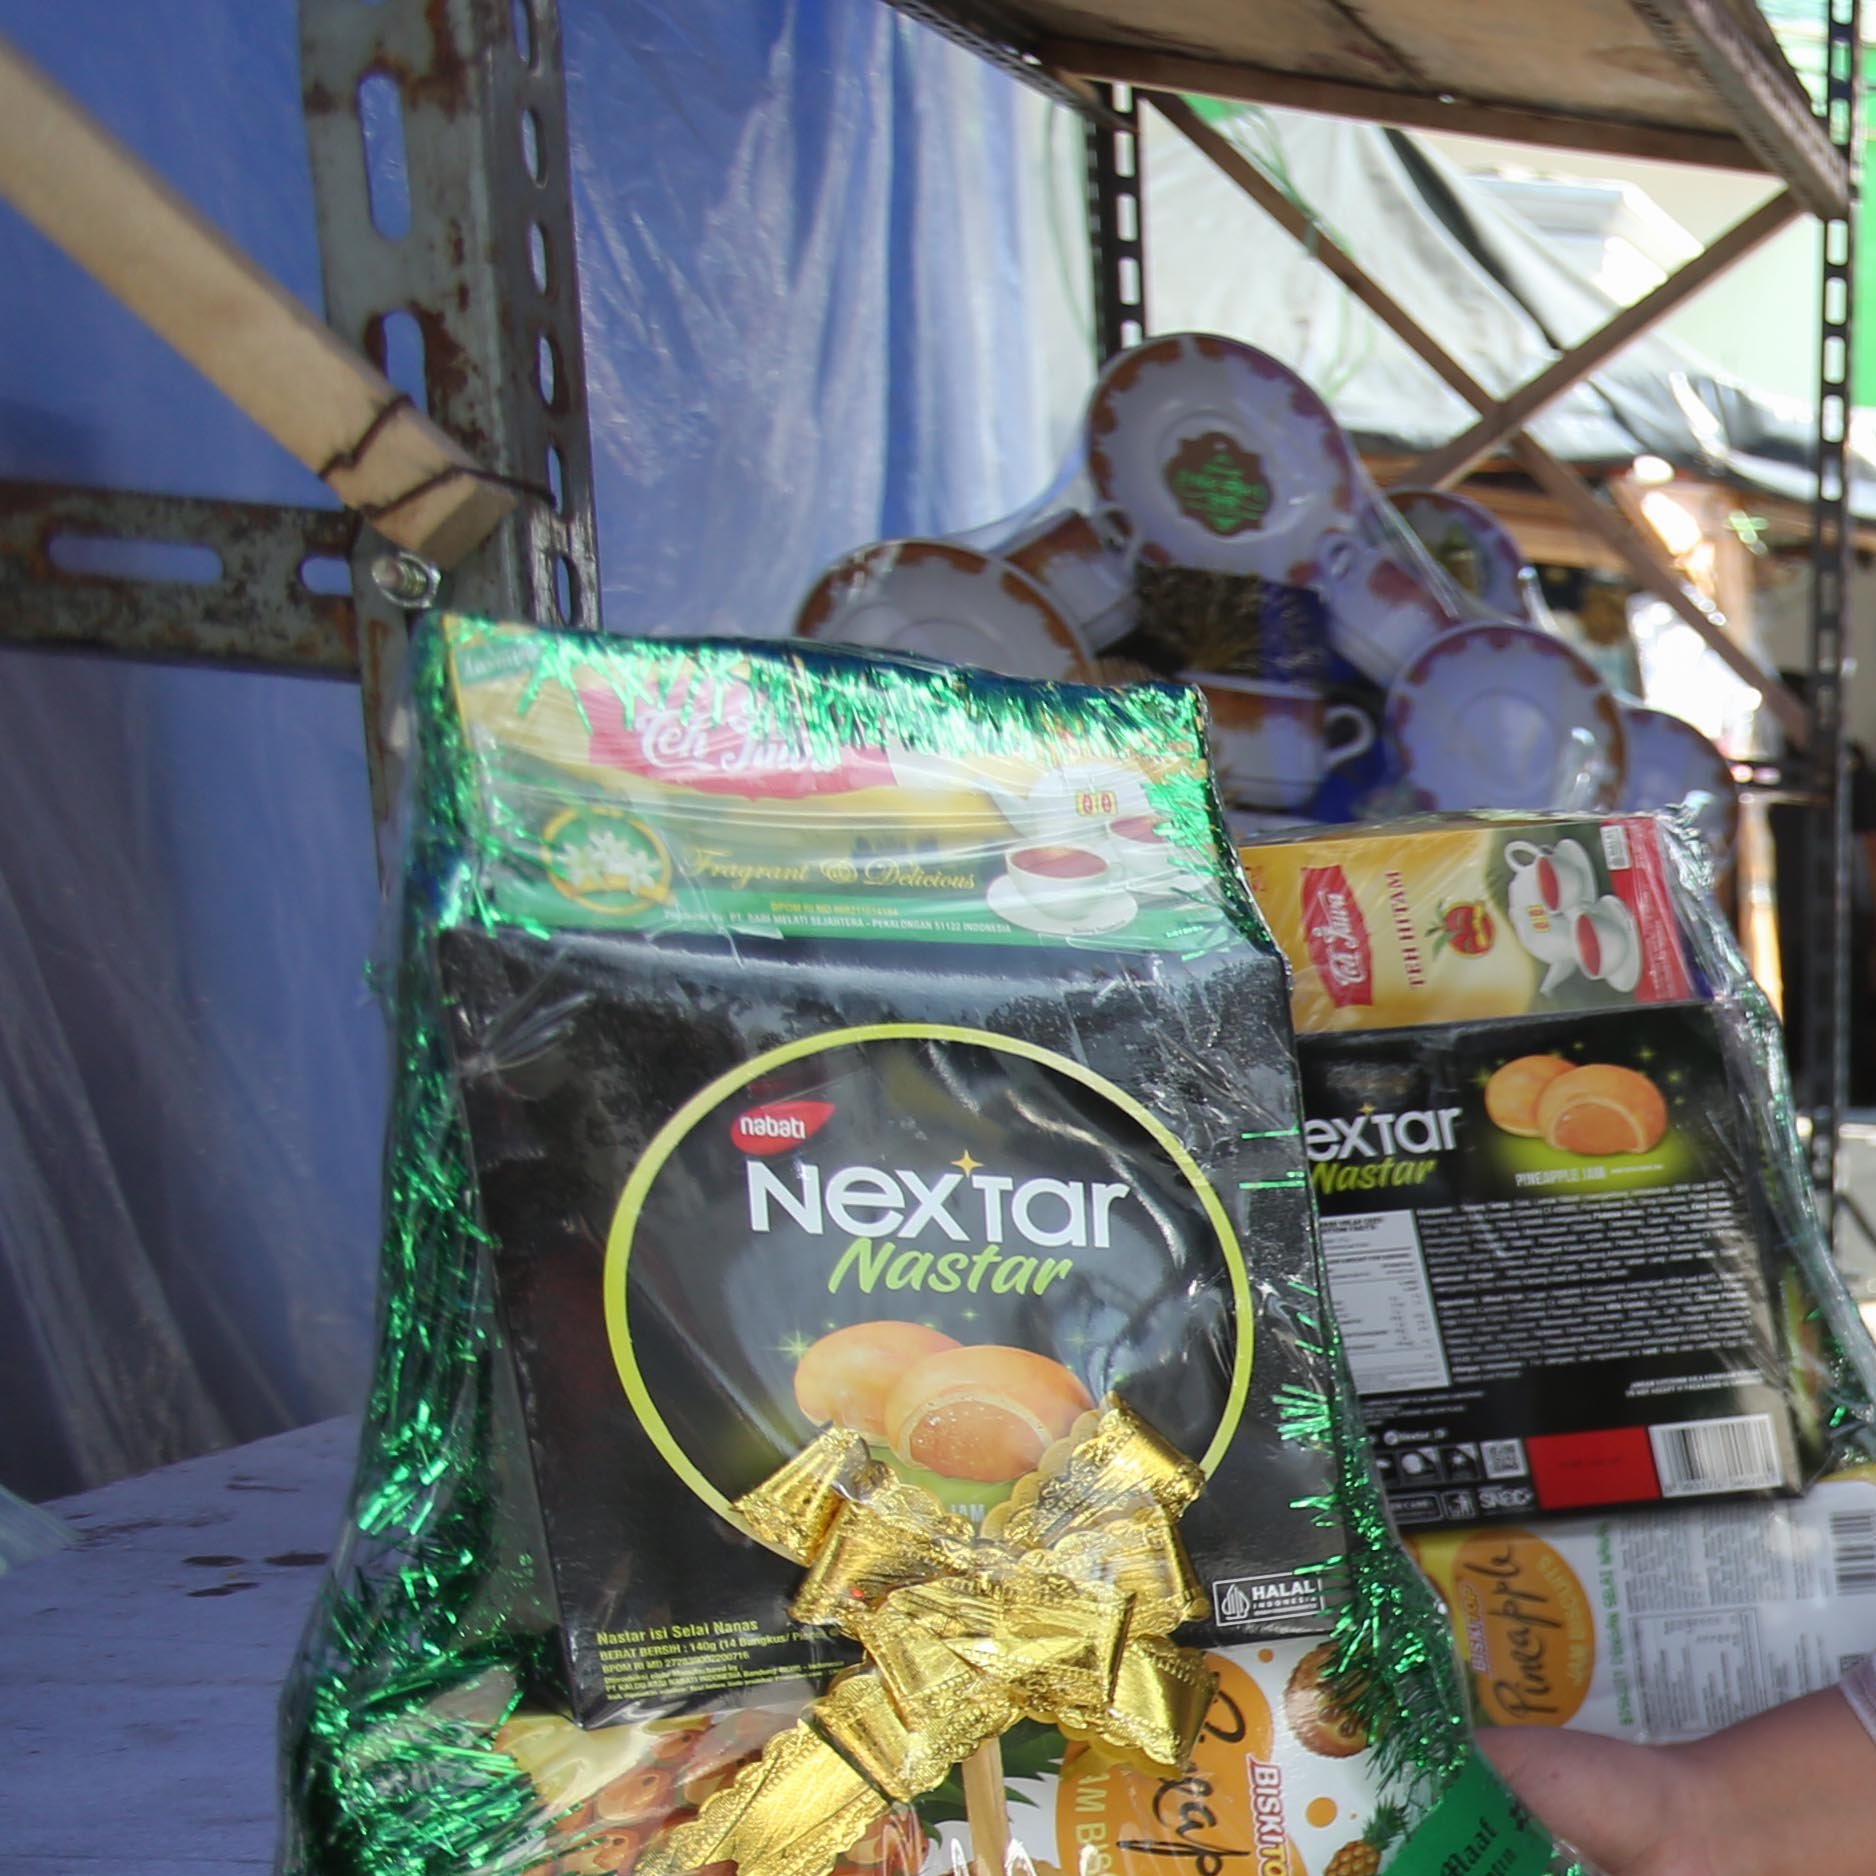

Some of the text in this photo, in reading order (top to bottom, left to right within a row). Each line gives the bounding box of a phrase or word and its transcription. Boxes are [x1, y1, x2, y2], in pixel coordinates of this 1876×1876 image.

[695, 848, 811, 892] Fragrant
[863, 857, 977, 890] Delicious
[1385, 870, 1426, 988] TEH HITAM
[740, 1110, 808, 1142] nabati
[1310, 1157, 1439, 1195] Nastar
[828, 1235, 1076, 1297] Nastar
[1251, 1579, 1317, 1601] HALAL
[596, 1629, 646, 1646] Nastar
[671, 1623, 711, 1639] Selai
[712, 1618, 760, 1636] Nanas
[1461, 1547, 1562, 1720] Pineapple
[599, 1647, 638, 1661] BERAT
[639, 1643, 682, 1659] BERSIH
